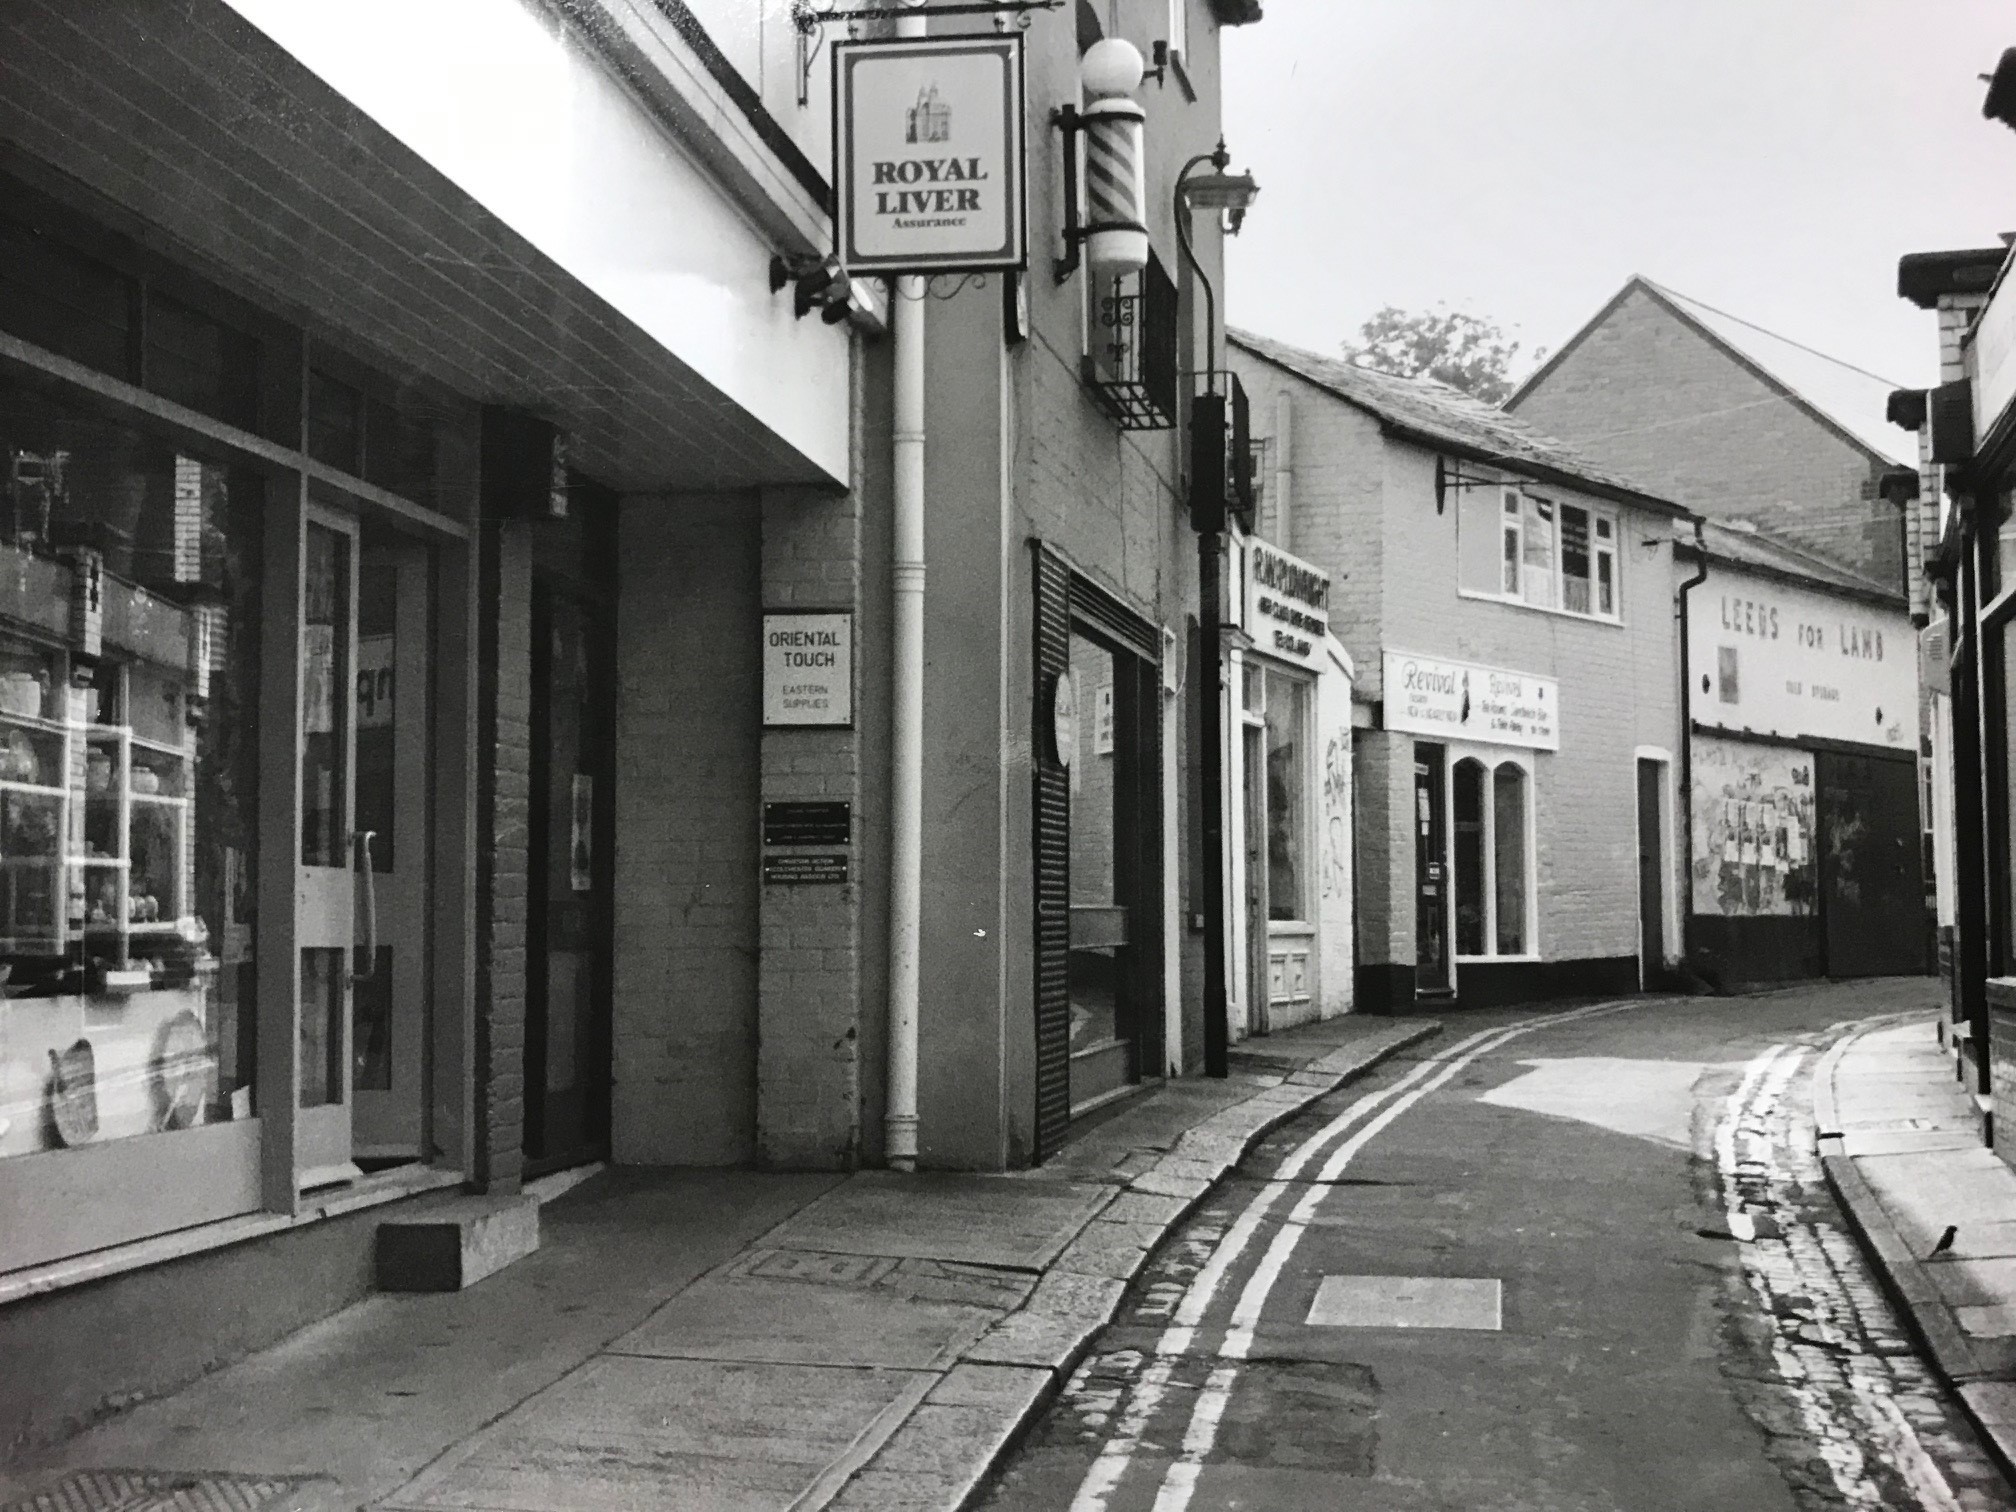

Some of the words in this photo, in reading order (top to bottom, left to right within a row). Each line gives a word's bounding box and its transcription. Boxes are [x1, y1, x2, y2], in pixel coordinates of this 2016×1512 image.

[872, 157, 988, 184] ROYAL
[875, 188, 982, 214] LIVER
[892, 216, 967, 229] Assurance
[1721, 595, 1779, 640] LEEDS
[1798, 623, 1823, 649] FOR
[1840, 623, 1884, 662] LAMB
[769, 631, 840, 647] ORIENTAL
[784, 652, 835, 668] TOUCH
[1403, 661, 1456, 695] Revival
[783, 685, 829, 696] EASTERN
[783, 698, 829, 709] SUPPLIES
